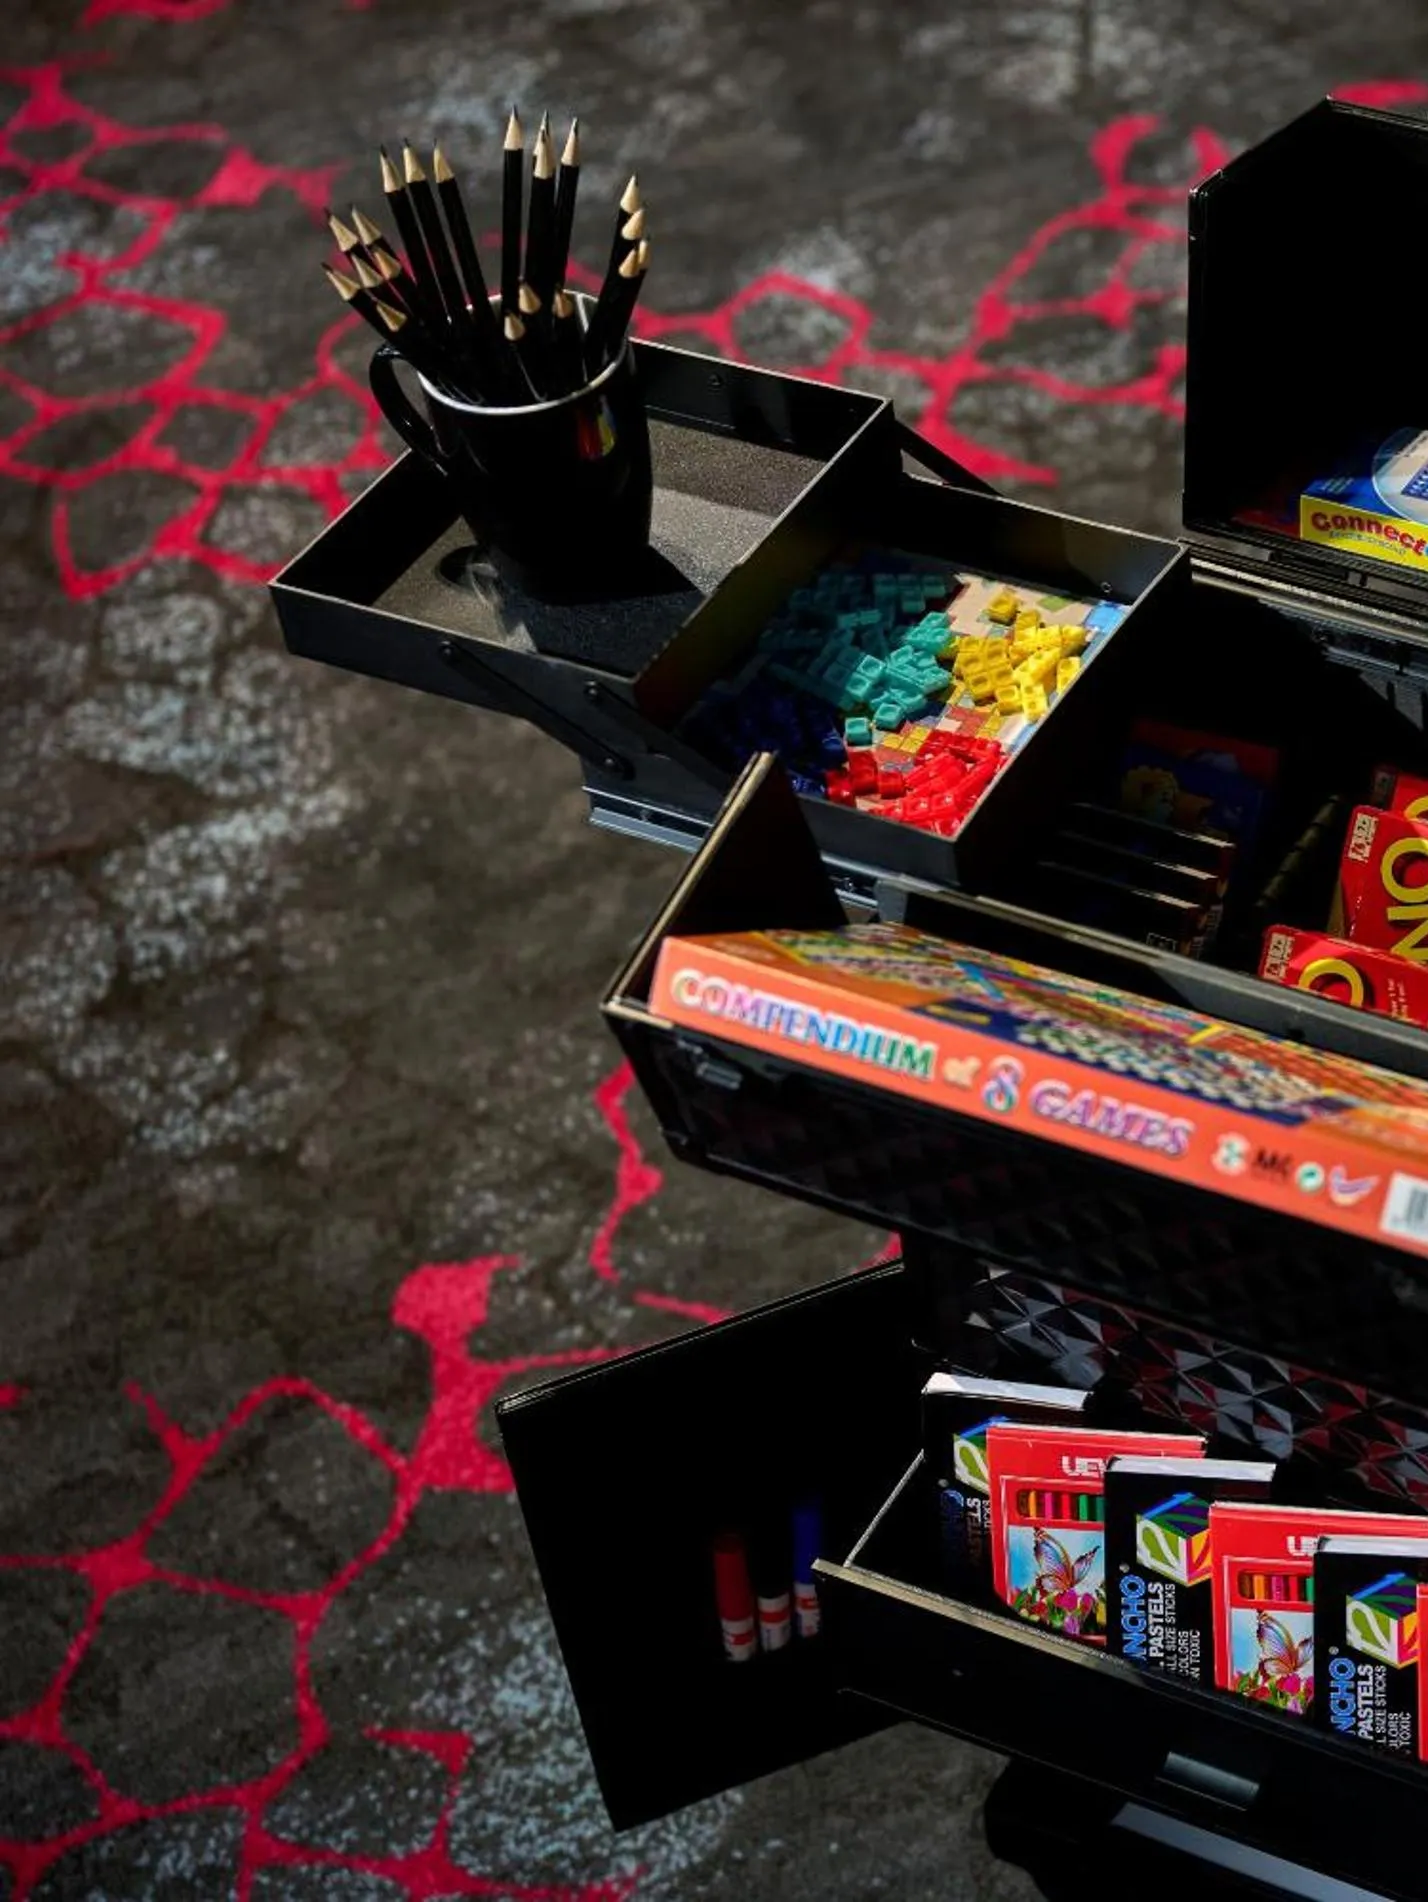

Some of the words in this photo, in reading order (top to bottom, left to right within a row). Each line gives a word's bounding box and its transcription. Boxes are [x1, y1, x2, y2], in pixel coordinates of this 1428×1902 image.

[1311, 511, 1427, 556] Connect
[670, 967, 940, 1082] COMPENDIUM
[981, 1054, 1026, 1114] 8
[1029, 1078, 1197, 1158] GAMES
[1061, 1455, 1104, 1478] UE
[1147, 1581, 1165, 1658] PASTELS
[1165, 1583, 1176, 1625] STICKS
[1165, 1628, 1176, 1652] SIZE
[1189, 1629, 1201, 1664] TOXIC
[1356, 1664, 1374, 1740] PASTELS
[1375, 1664, 1387, 1707] STICKS
[1399, 1710, 1412, 1747] TOXIC
